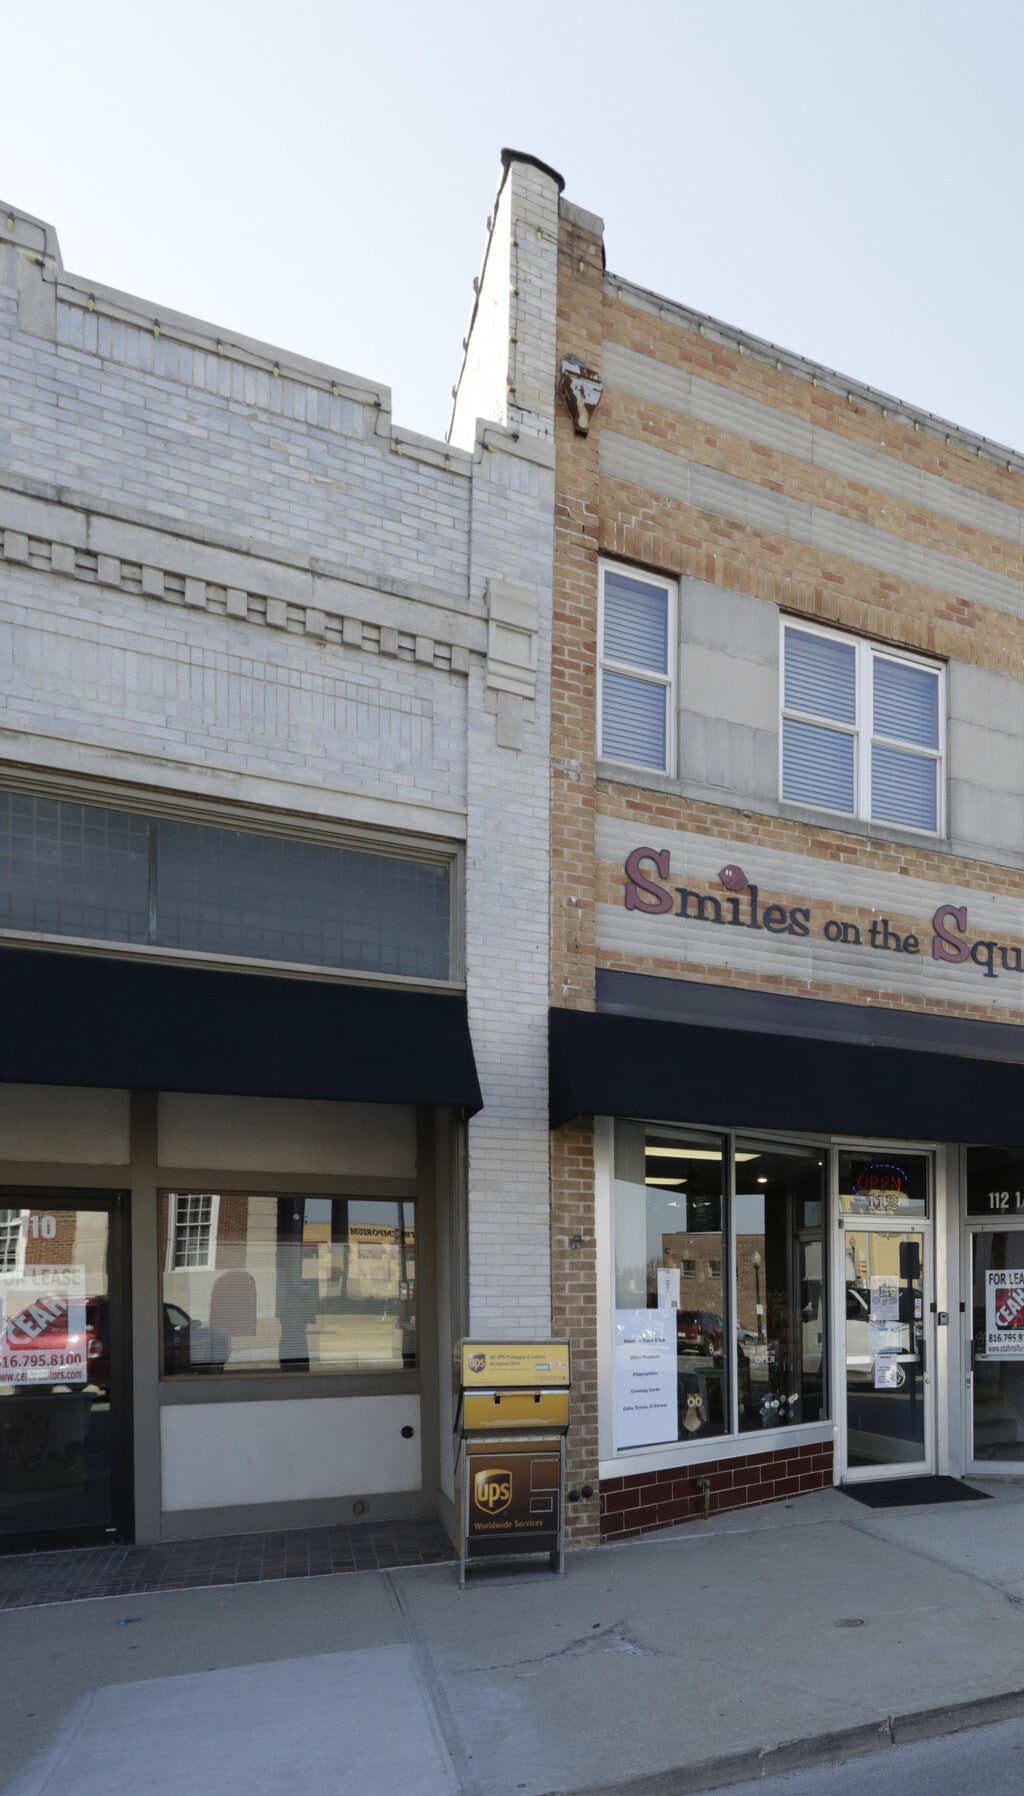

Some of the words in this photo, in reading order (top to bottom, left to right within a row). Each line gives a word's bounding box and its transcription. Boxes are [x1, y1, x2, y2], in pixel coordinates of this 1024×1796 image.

[625, 846, 810, 937] Smiles
[823, 919, 862, 945] on
[869, 919, 921, 955] the
[857, 1174, 902, 1192] OPEN
[868, 1194, 899, 1211] 112
[989, 1191, 1009, 1209] 112
[33, 1268, 81, 1286] LEASE
[988, 1273, 1006, 1285] FOR
[0, 1353, 82, 1368] 16.795.8100
[469, 1358, 485, 1371] ups
[477, 1483, 510, 1508] ups
[474, 1521, 513, 1530] Worldwide
[514, 1520, 543, 1528] Services
